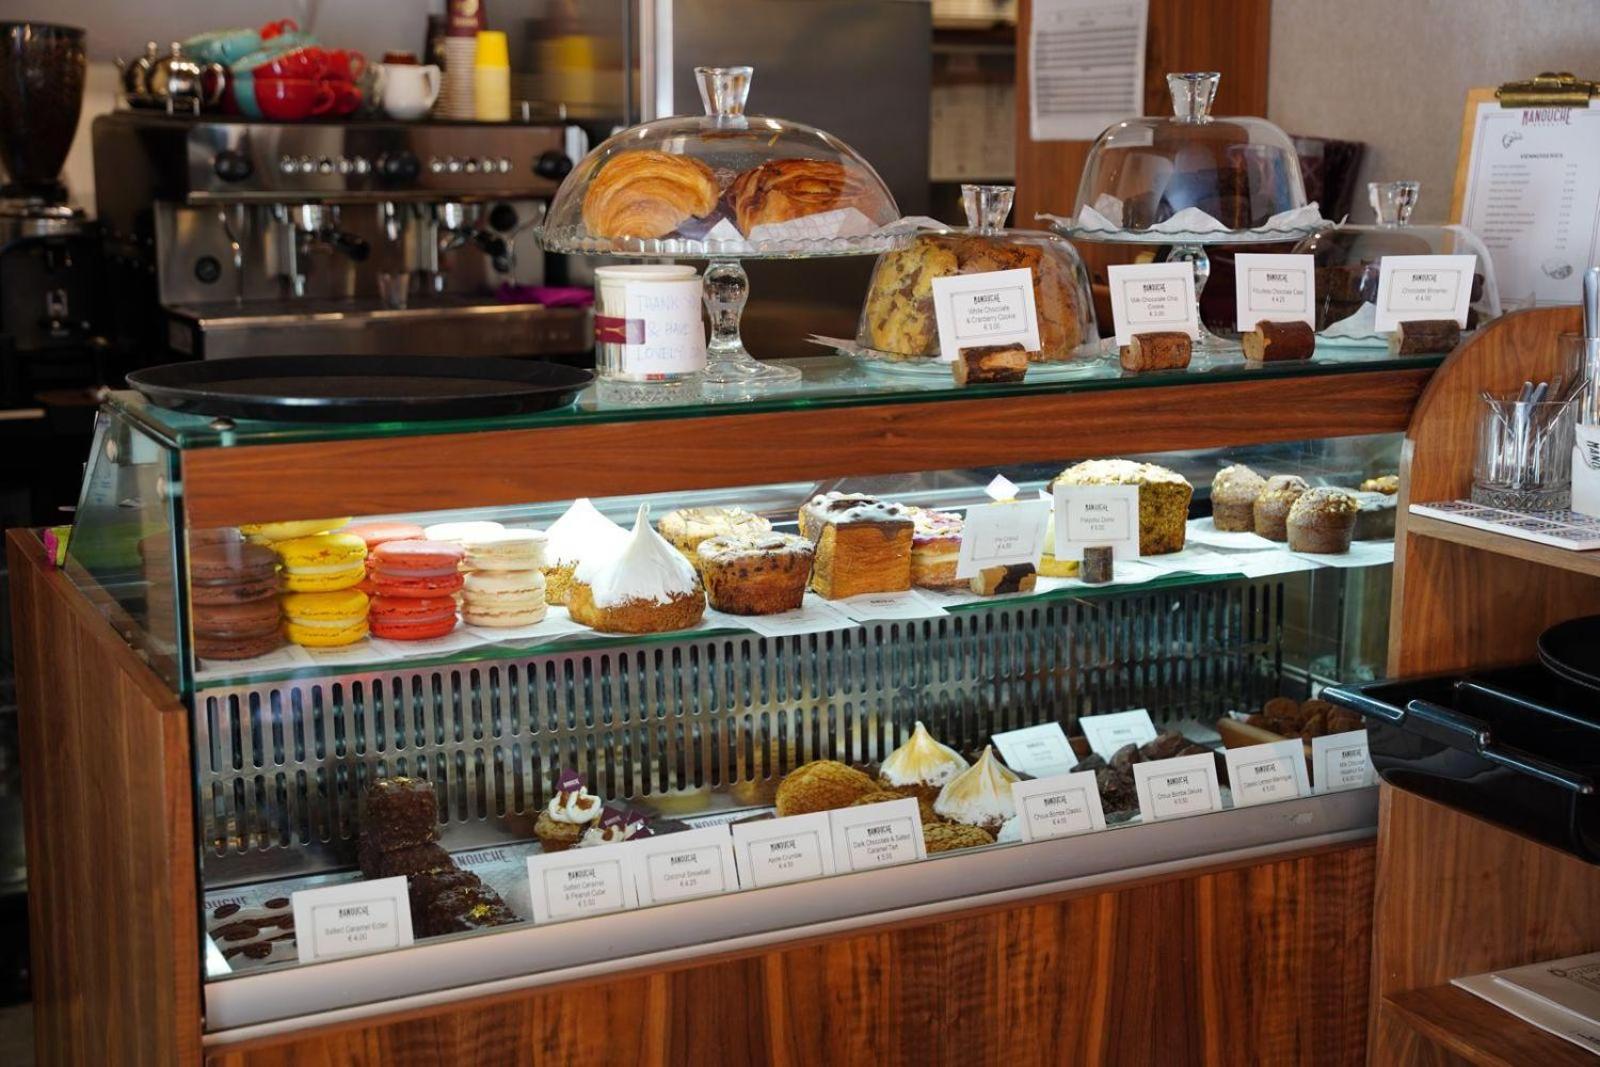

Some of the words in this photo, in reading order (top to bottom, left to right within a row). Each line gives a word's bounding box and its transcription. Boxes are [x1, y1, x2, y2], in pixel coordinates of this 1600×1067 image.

[1522, 107, 1573, 126] MANOUCHE
[973, 293, 1001, 304] MANOUCHE
[968, 307, 983, 315] White
[984, 305, 1010, 313] Chocolate
[971, 315, 997, 324] Cranberry
[770, 840, 797, 852] MANOUCHE
[865, 837, 890, 846] Chocolate
[670, 853, 698, 866] MANOUCHE
[567, 868, 597, 881] MANOUCHE
[339, 905, 370, 918] MANOUCHE
[345, 923, 371, 933] Caramel
